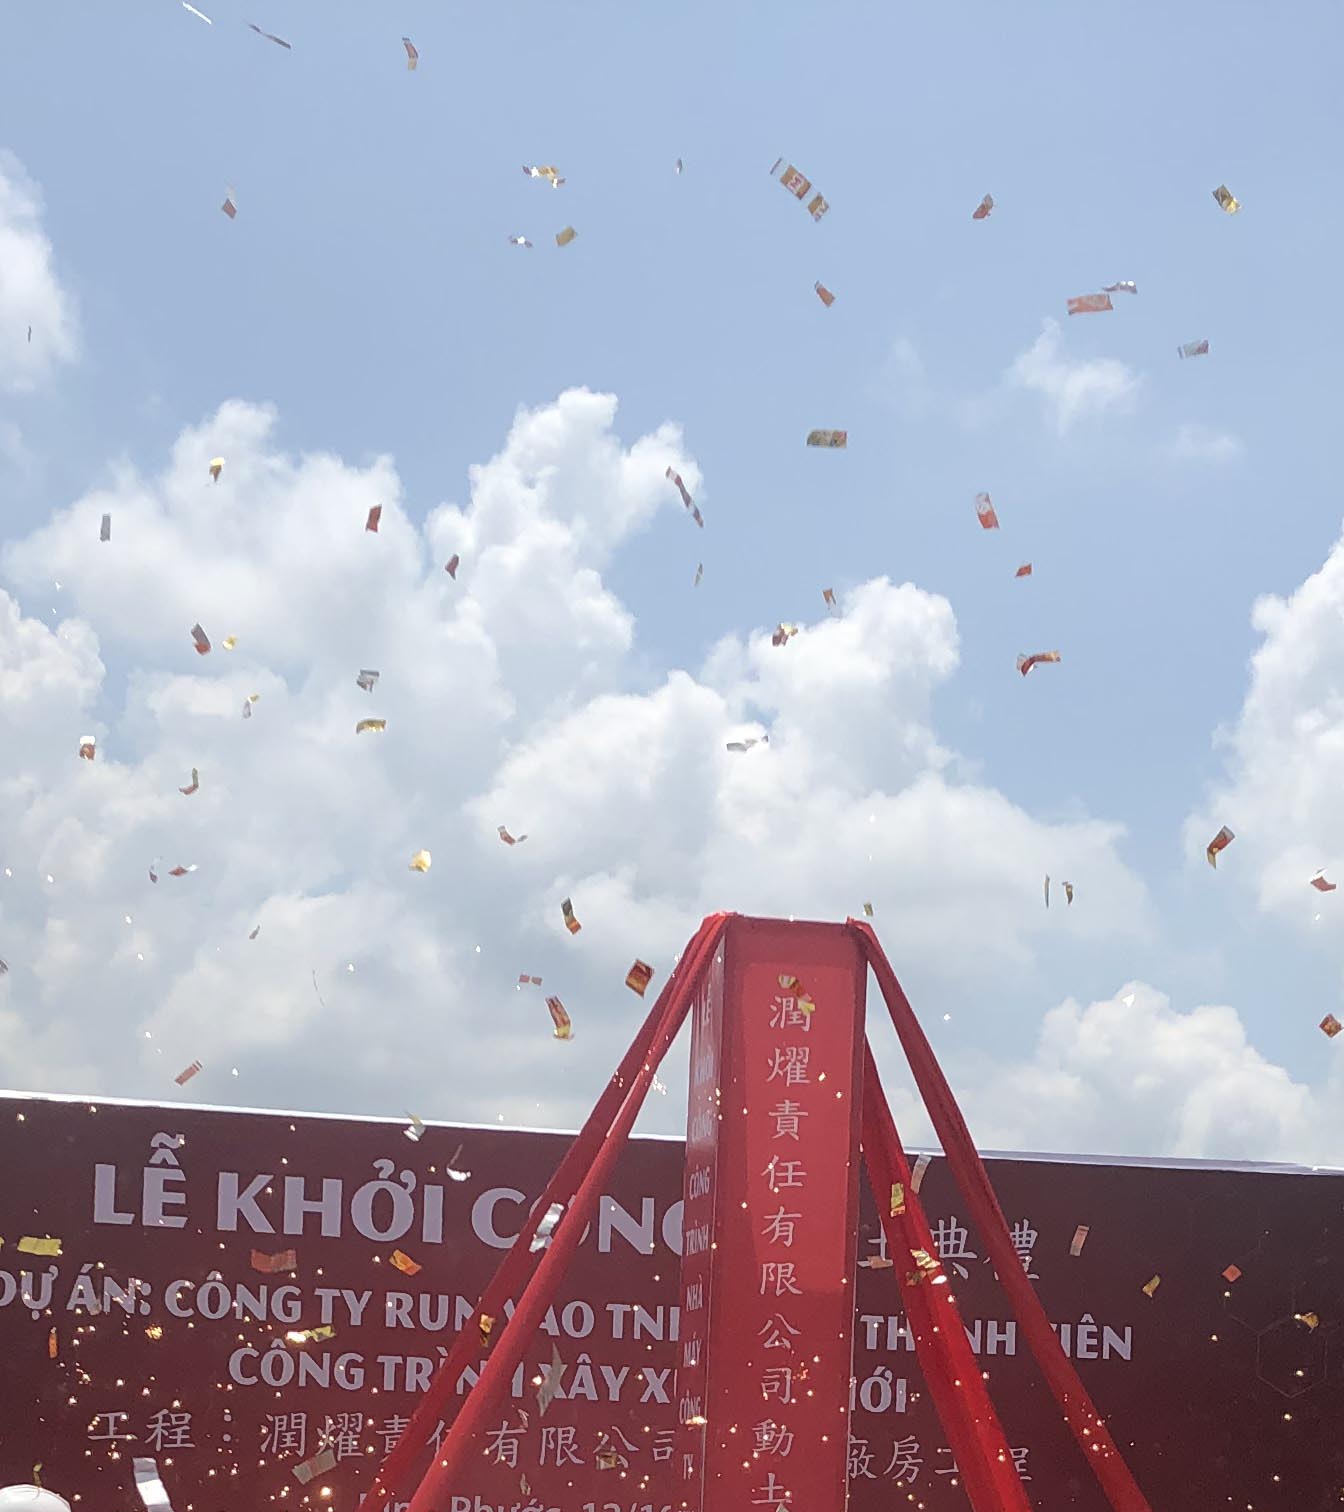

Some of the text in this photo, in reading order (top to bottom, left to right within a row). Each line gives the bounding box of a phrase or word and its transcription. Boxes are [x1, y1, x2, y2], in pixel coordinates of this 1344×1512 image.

[93, 1132, 187, 1229] LỄ
[216, 1158, 444, 1245] KHỞI
[471, 1186, 685, 1257] CN
[164, 1270, 302, 1325] CÔNG
[314, 1287, 373, 1327] TY
[860, 1314, 1017, 1356] THNH
[1049, 1312, 1133, 1361] IÊN
[228, 1338, 365, 1391] CÔNG
[849, 1365, 907, 1413] ỚI
